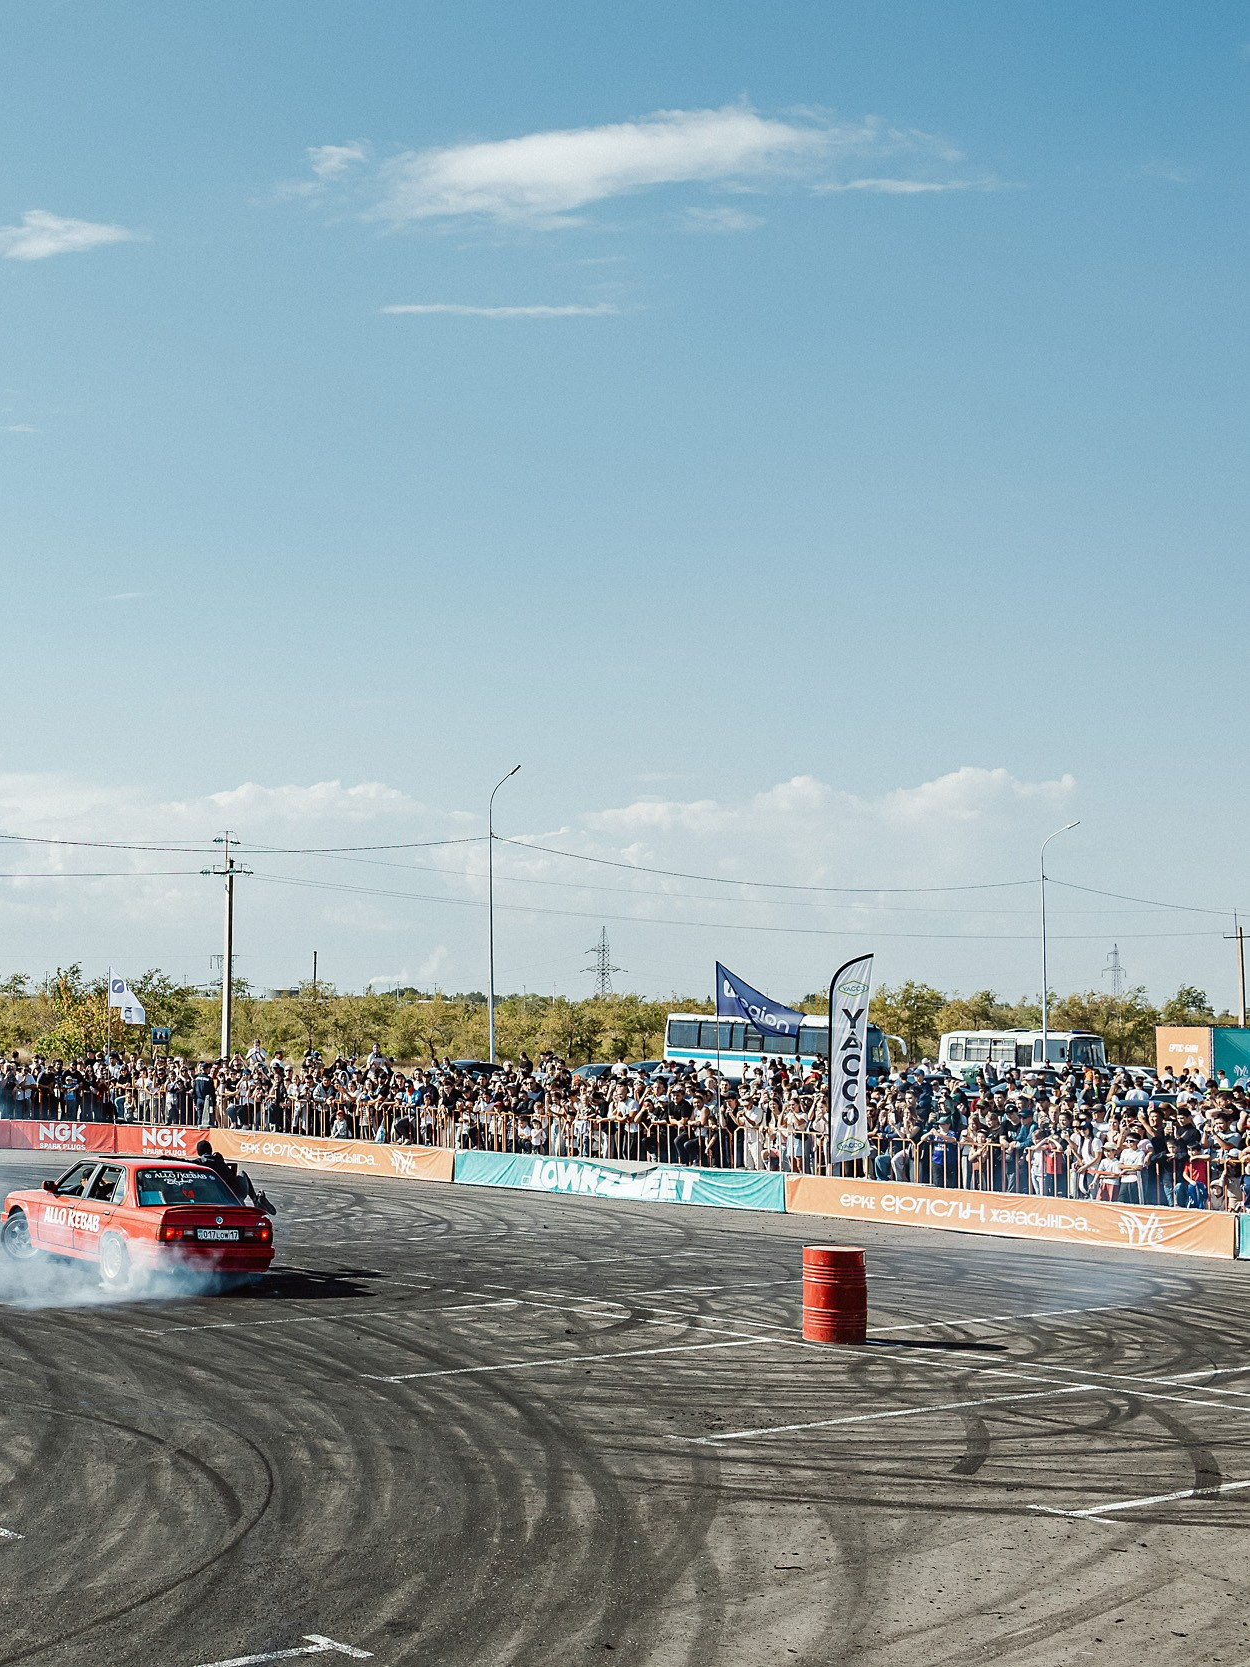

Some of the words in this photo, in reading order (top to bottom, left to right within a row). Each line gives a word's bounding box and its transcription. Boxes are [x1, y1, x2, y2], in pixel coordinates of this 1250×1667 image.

[840, 1008, 865, 1126] YACCO
[39, 1123, 87, 1144] NGK
[141, 1127, 187, 1148] NGK
[39, 1142, 63, 1150] SPARK
[64, 1143, 86, 1151] PLUGS
[142, 1147, 164, 1155] SPARK
[165, 1148, 187, 1156] PLUGS
[43, 1206, 67, 1226] ALLO
[67, 1209, 101, 1233] KEBAB
[203, 1230, 216, 1239] 017
[230, 1231, 238, 1240] 17
